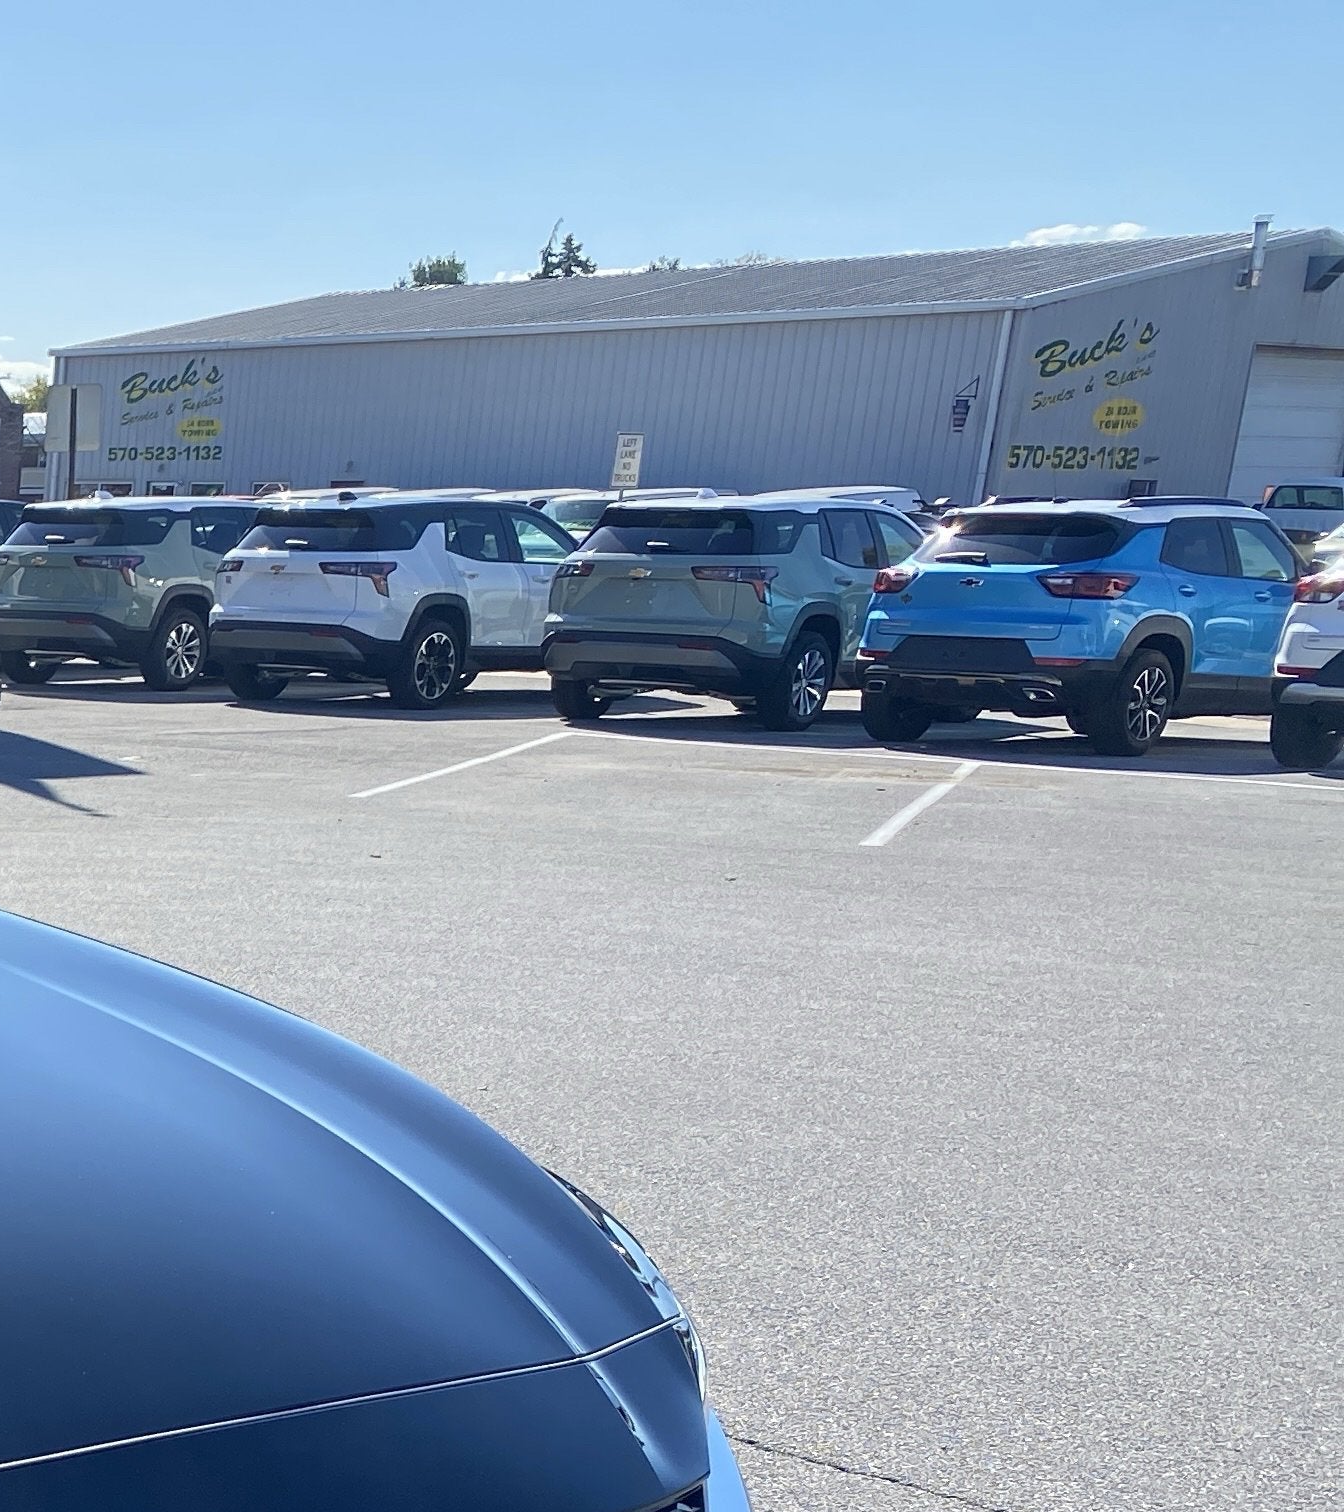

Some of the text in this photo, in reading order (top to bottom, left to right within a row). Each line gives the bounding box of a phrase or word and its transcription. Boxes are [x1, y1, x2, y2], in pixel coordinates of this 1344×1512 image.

[1034, 317, 1161, 378] Buck's
[120, 357, 224, 404] Buck's
[1099, 418, 1139, 430] TOWING
[107, 445, 223, 461] 570-523-1132
[1007, 445, 1140, 470] 570-523-1132
